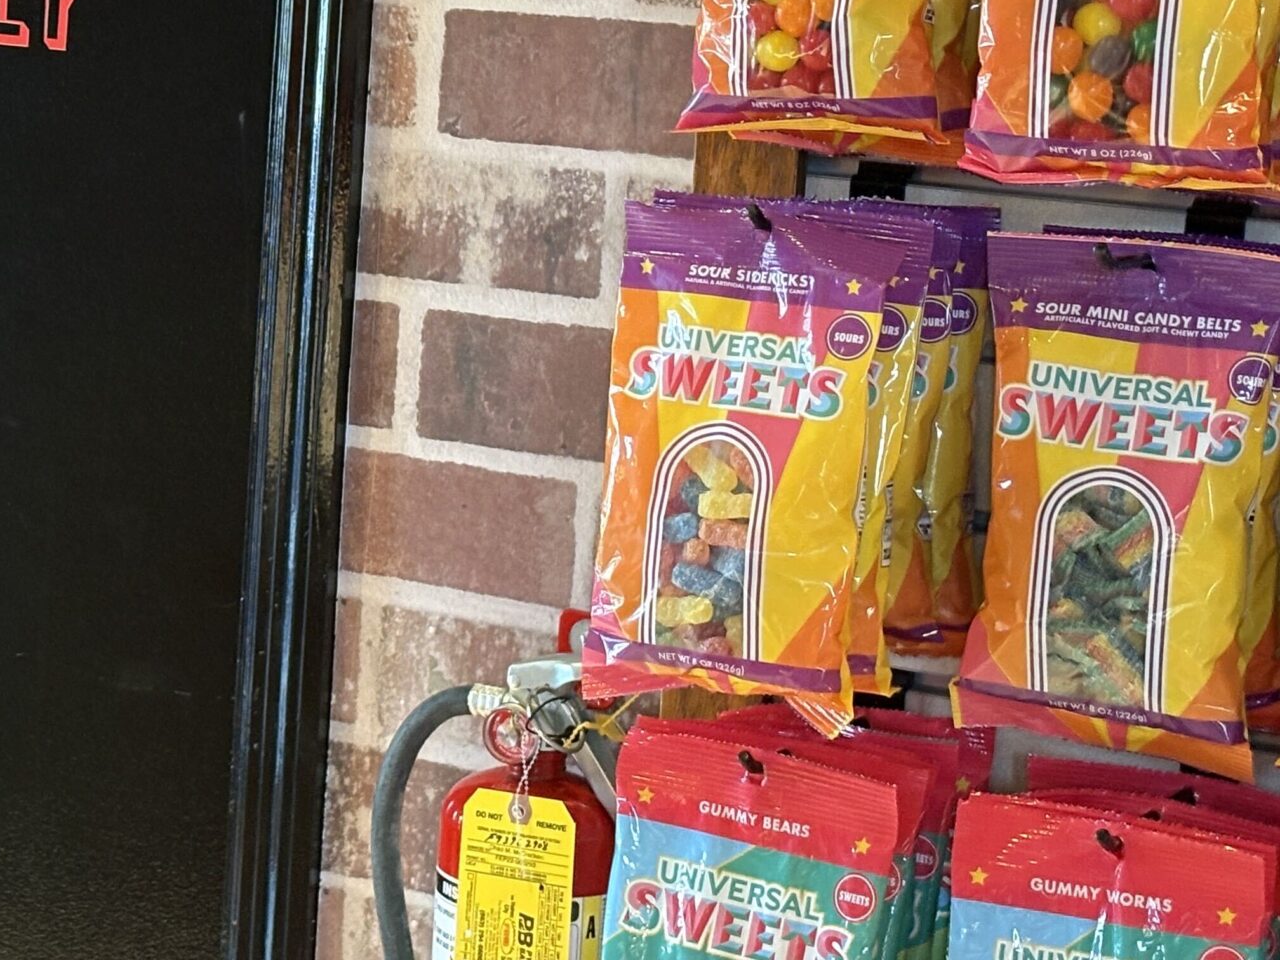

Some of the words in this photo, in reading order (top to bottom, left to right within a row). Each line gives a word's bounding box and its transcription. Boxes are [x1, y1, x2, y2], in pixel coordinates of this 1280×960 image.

[1049, 145, 1069, 154] NET
[1069, 147, 1088, 156] WT
[1090, 149, 1097, 157] 8
[1100, 149, 1116, 158] OZ
[1119, 149, 1152, 161] (226g)
[688, 264, 732, 280] SOUR
[735, 268, 810, 288] SIDEKICKS
[922, 317, 945, 327] OURS
[952, 307, 970, 319] URS
[1035, 302, 1083, 317] SOUR
[1086, 305, 1129, 322] MINI
[1134, 311, 1192, 330] CANDY
[1196, 316, 1242, 332] BELTS
[834, 332, 865, 344] SOURS
[882, 325, 900, 336] URS
[1044, 314, 1097, 326] ARTIFICIALLY
[1097, 321, 1141, 333] FLAVORED
[1142, 325, 1160, 334] SOFT
[1171, 328, 1200, 338] CHEWY
[1200, 330, 1230, 340] CANDY
[661, 325, 813, 365] UNIVERSAL
[626, 346, 847, 420] SWEETS
[1031, 362, 1212, 407] UNIVERSAL
[996, 383, 1249, 465] SWEETS
[658, 652, 676, 660] NET
[677, 655, 690, 664] WT
[715, 662, 745, 677] (226g)
[1048, 700, 1068, 708] NET
[1070, 702, 1086, 710] WT
[1097, 706, 1113, 716] OZ
[1115, 710, 1148, 723] (226g)
[475, 810, 487, 818] DO
[488, 812, 503, 821] NOT
[536, 820, 568, 833] REMOVE
[699, 800, 758, 827] GUMMY
[762, 816, 811, 838] BEARS
[660, 858, 823, 922] UNIVERSAL
[838, 889, 870, 908] SWEETS
[1030, 877, 1102, 901] GUMMY
[1106, 889, 1173, 913] WORMS
[585, 915, 596, 939] A
[620, 878, 854, 960] SWEETS
